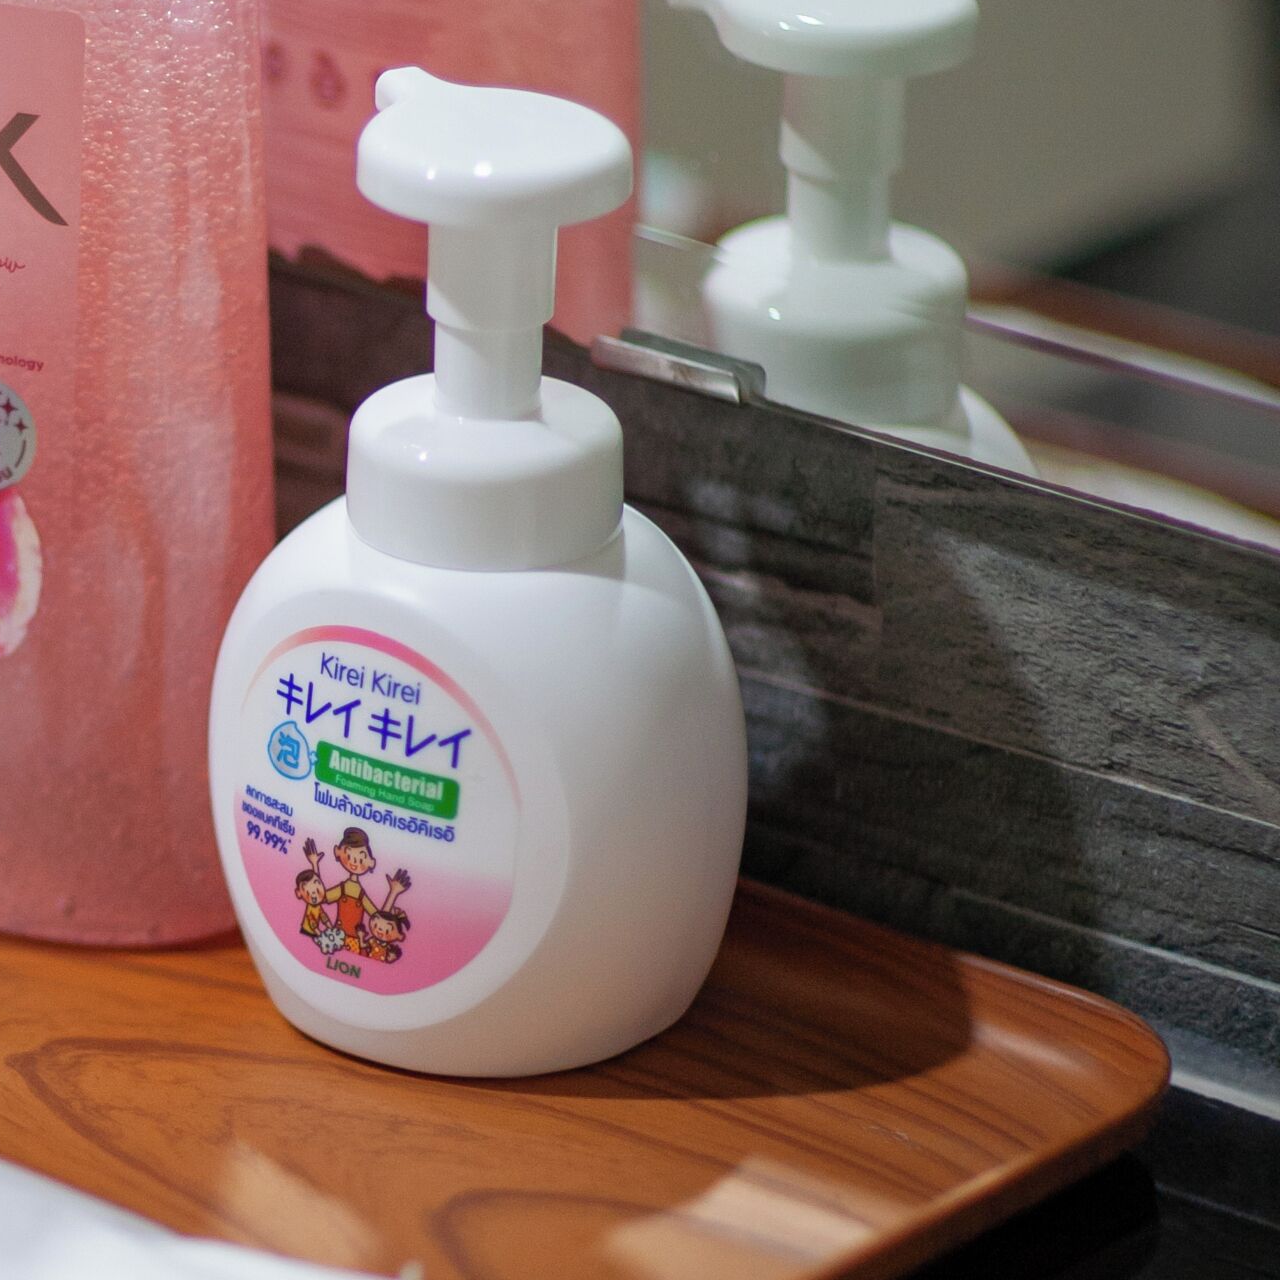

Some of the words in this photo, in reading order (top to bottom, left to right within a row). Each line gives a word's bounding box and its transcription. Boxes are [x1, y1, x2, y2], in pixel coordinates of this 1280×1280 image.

[320, 651, 366, 689] Kirei
[371, 669, 423, 706] Kirei
[328, 748, 445, 801] Antibacterial
[335, 773, 377, 798] Foaming
[379, 786, 406, 805] Hand
[408, 794, 436, 814] Soap
[326, 956, 362, 979] LION
